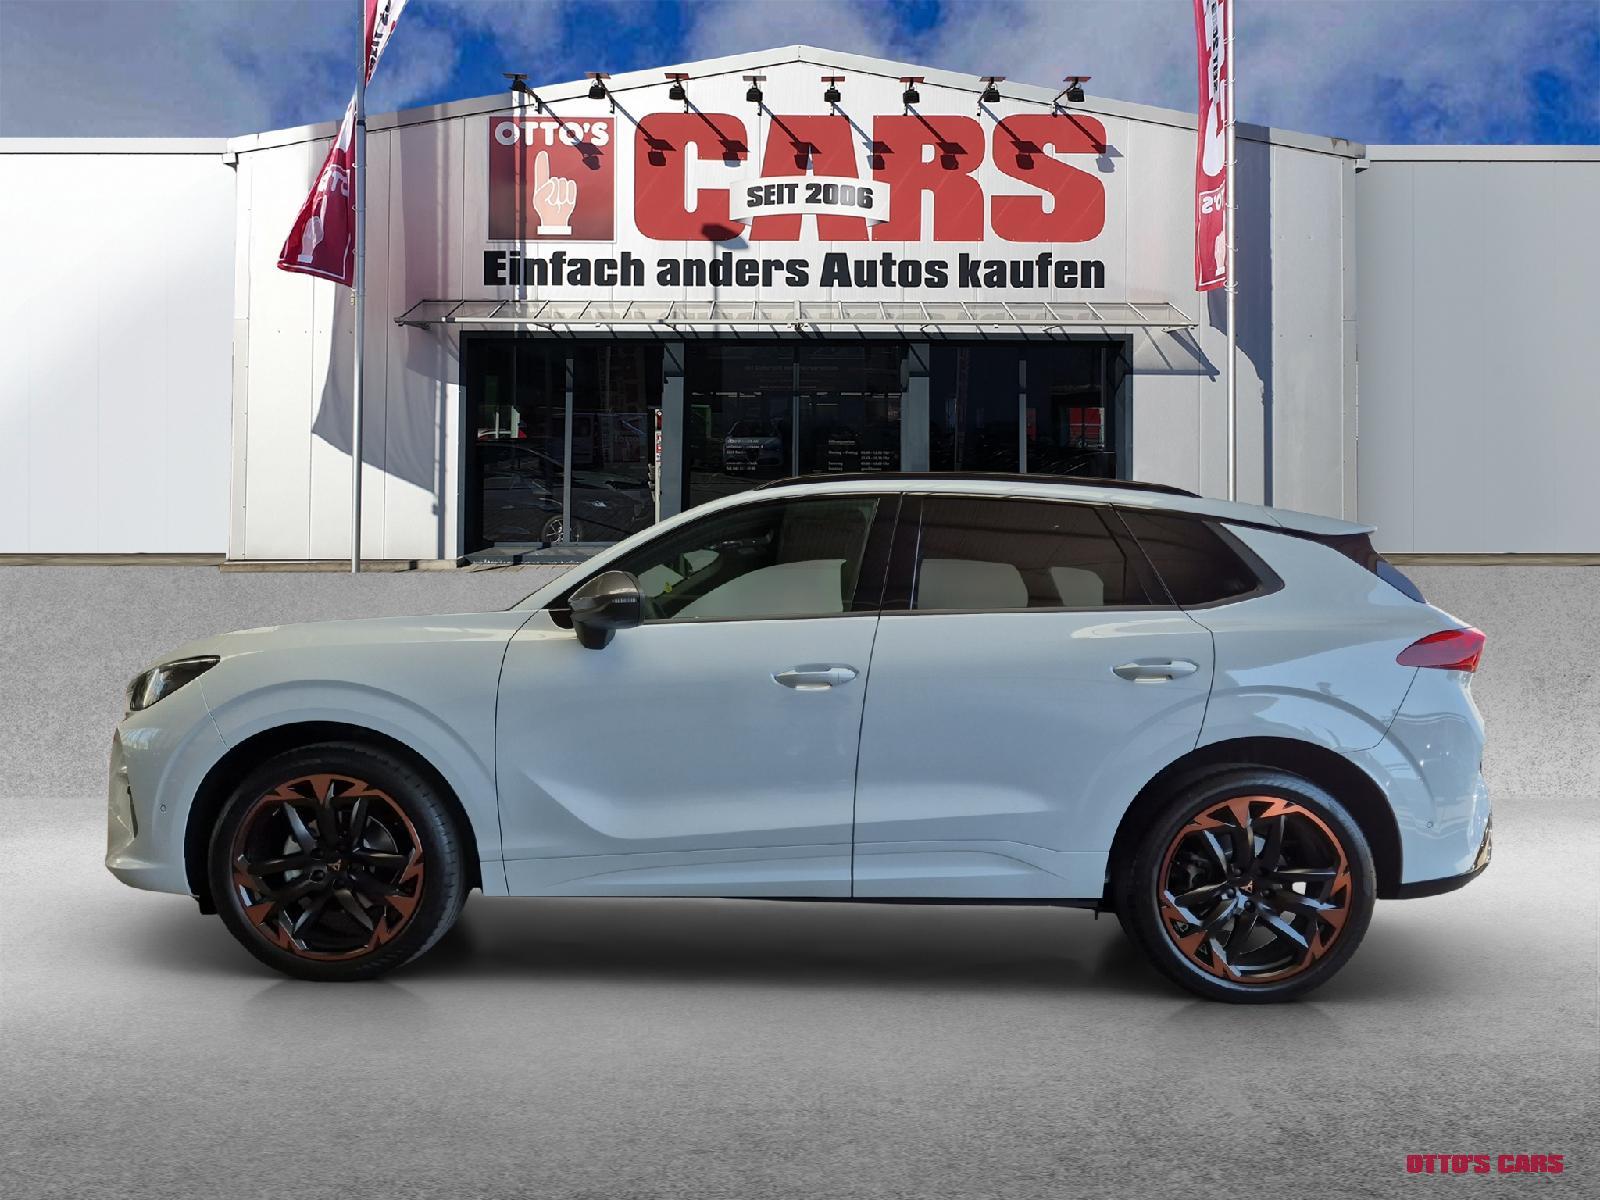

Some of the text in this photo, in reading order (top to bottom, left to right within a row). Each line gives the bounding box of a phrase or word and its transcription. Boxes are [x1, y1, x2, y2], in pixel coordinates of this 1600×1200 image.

[494, 121, 610, 146] OTTO'S
[634, 112, 1107, 242] CARS
[747, 182, 874, 210] SEIT 2006
[483, 250, 1106, 288] Einfach anders Autos kaufen
